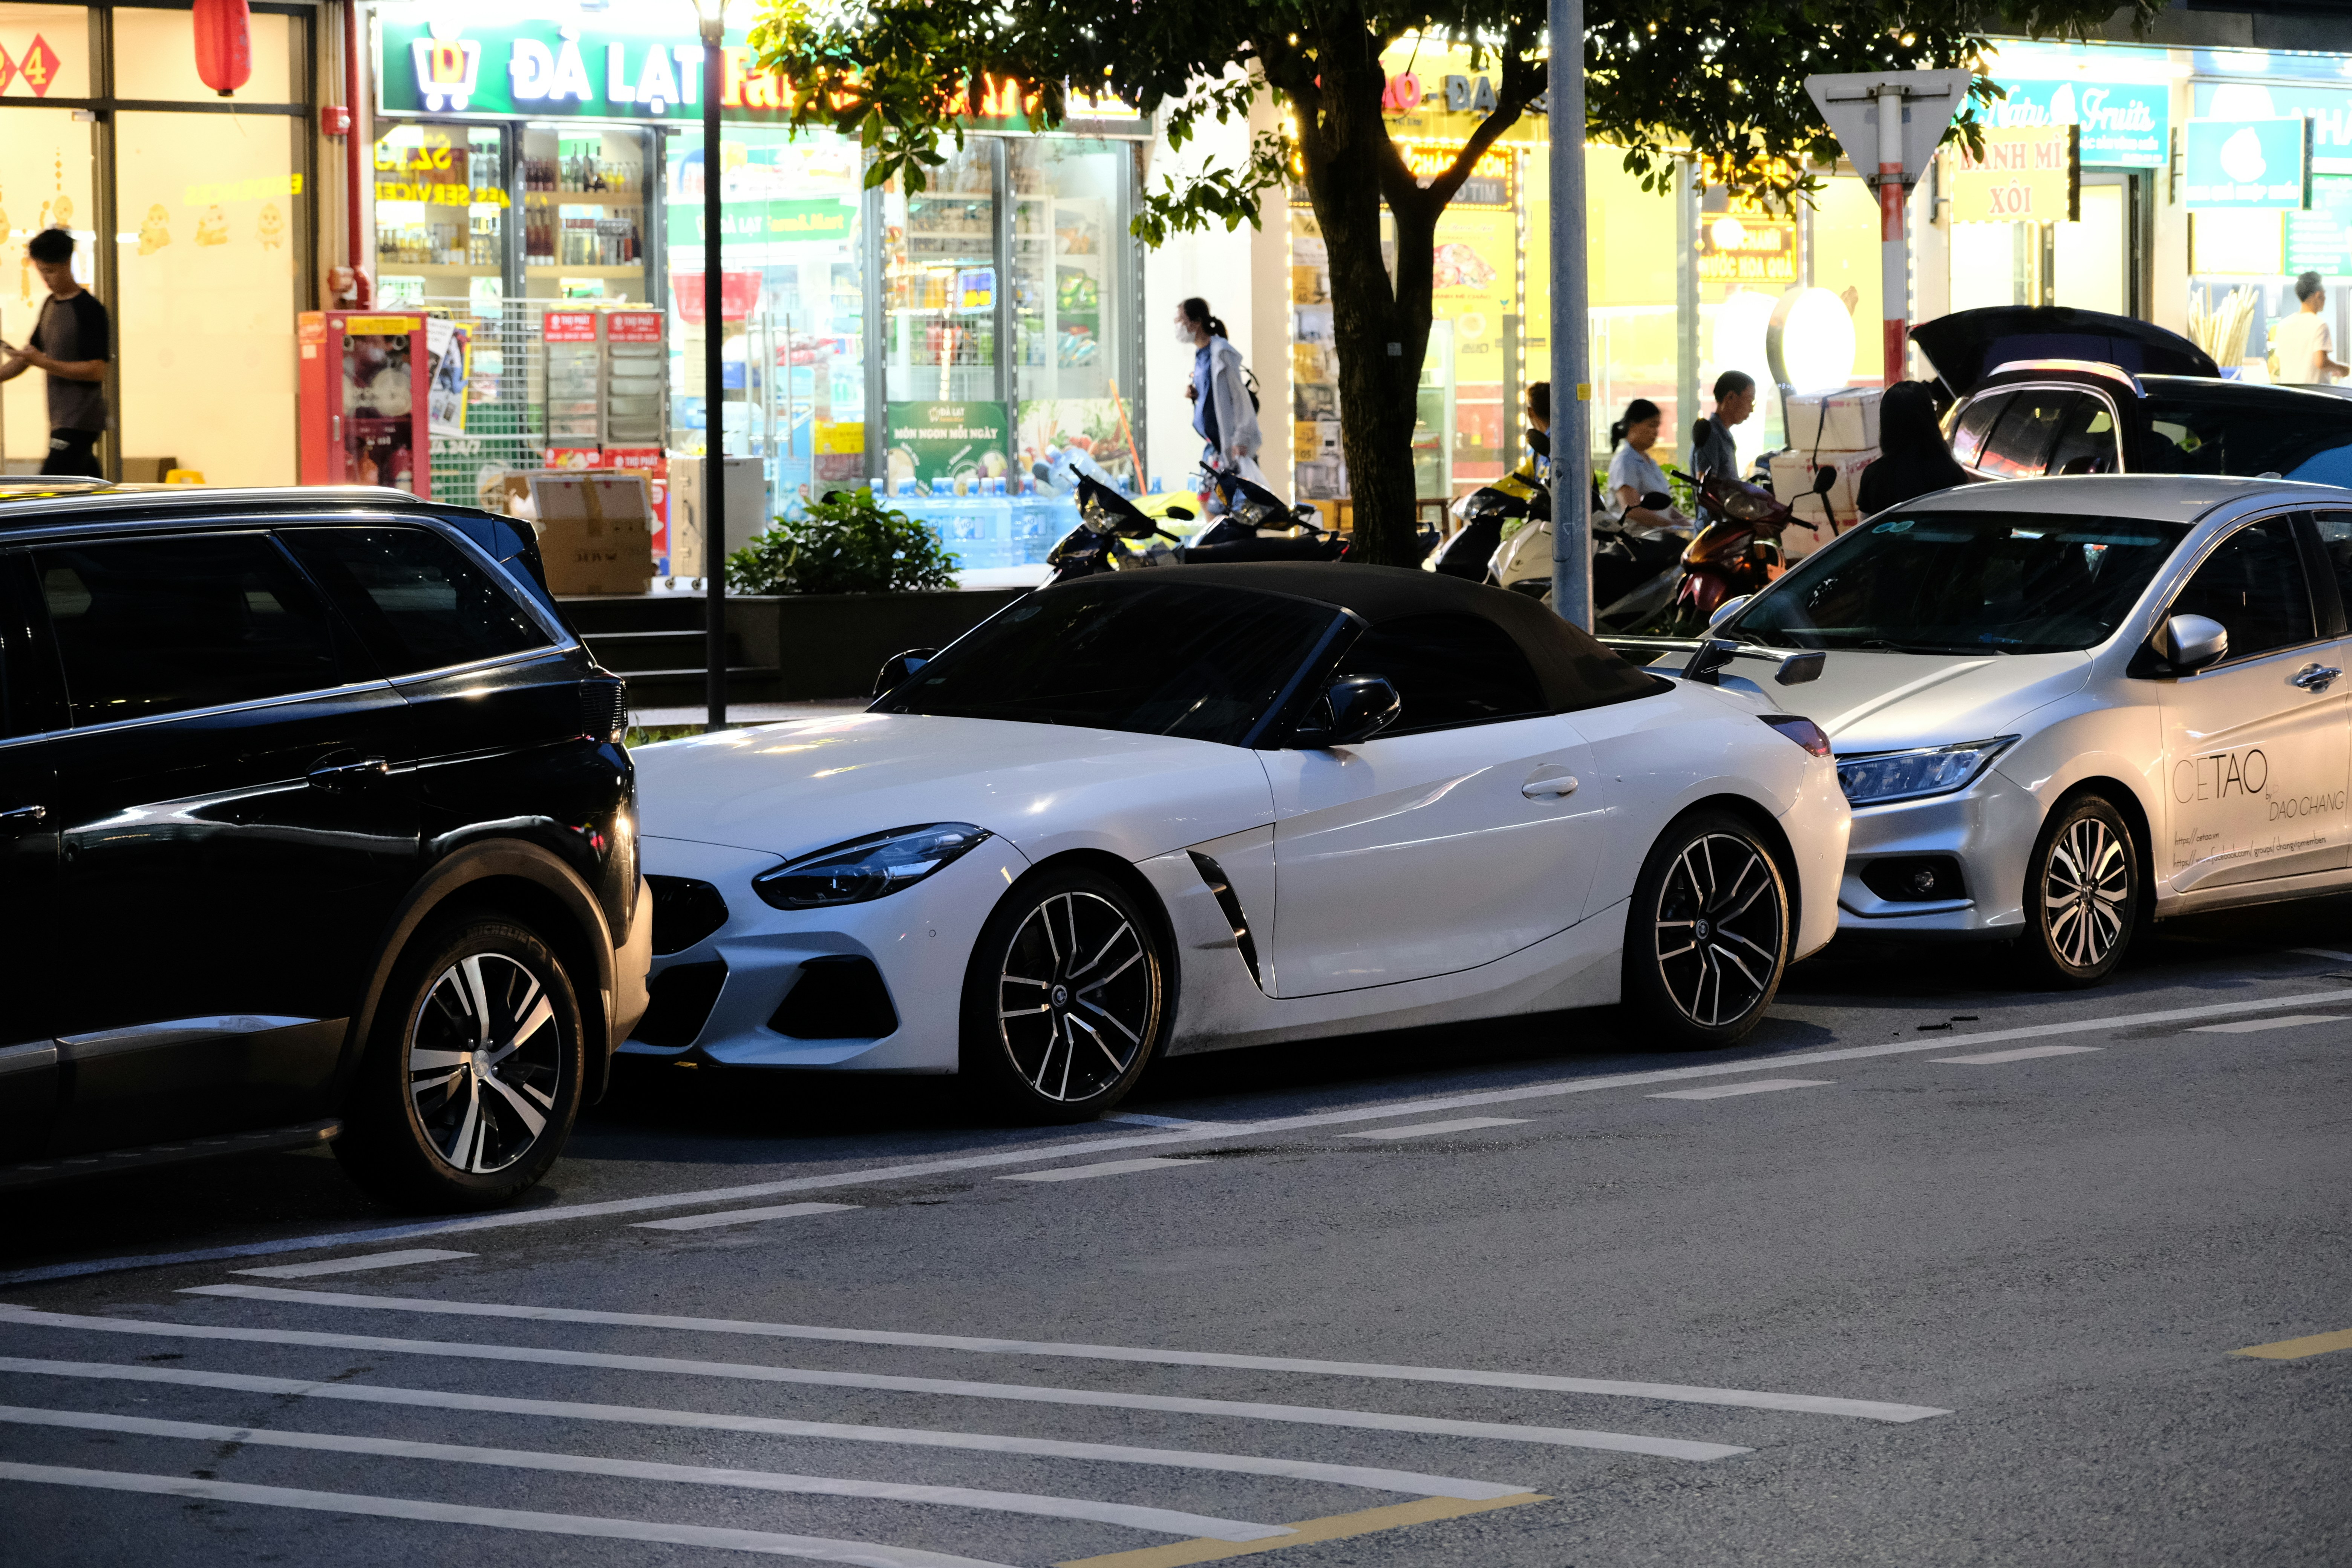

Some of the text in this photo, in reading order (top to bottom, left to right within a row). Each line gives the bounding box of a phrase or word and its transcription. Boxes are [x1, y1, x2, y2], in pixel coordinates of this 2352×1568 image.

[507, 24, 593, 100] ĐÀ
[608, 42, 704, 114] LẠT
[2081, 87, 2155, 132] Fruits
[2035, 134, 2061, 168] MÌ
[1470, 183, 1497, 202] TIM
[1990, 179, 2031, 213] XÔI
[1738, 256, 1766, 278] HOA
[1766, 250, 1793, 278] QUẢ
[894, 425, 917, 439] MÓN
[918, 428, 948, 439] NGON
[969, 426, 998, 439] NGÀY
[2173, 749, 2268, 803] CETAO
[2265, 784, 2272, 802] by
[2269, 791, 2345, 821] DAO CHANG
